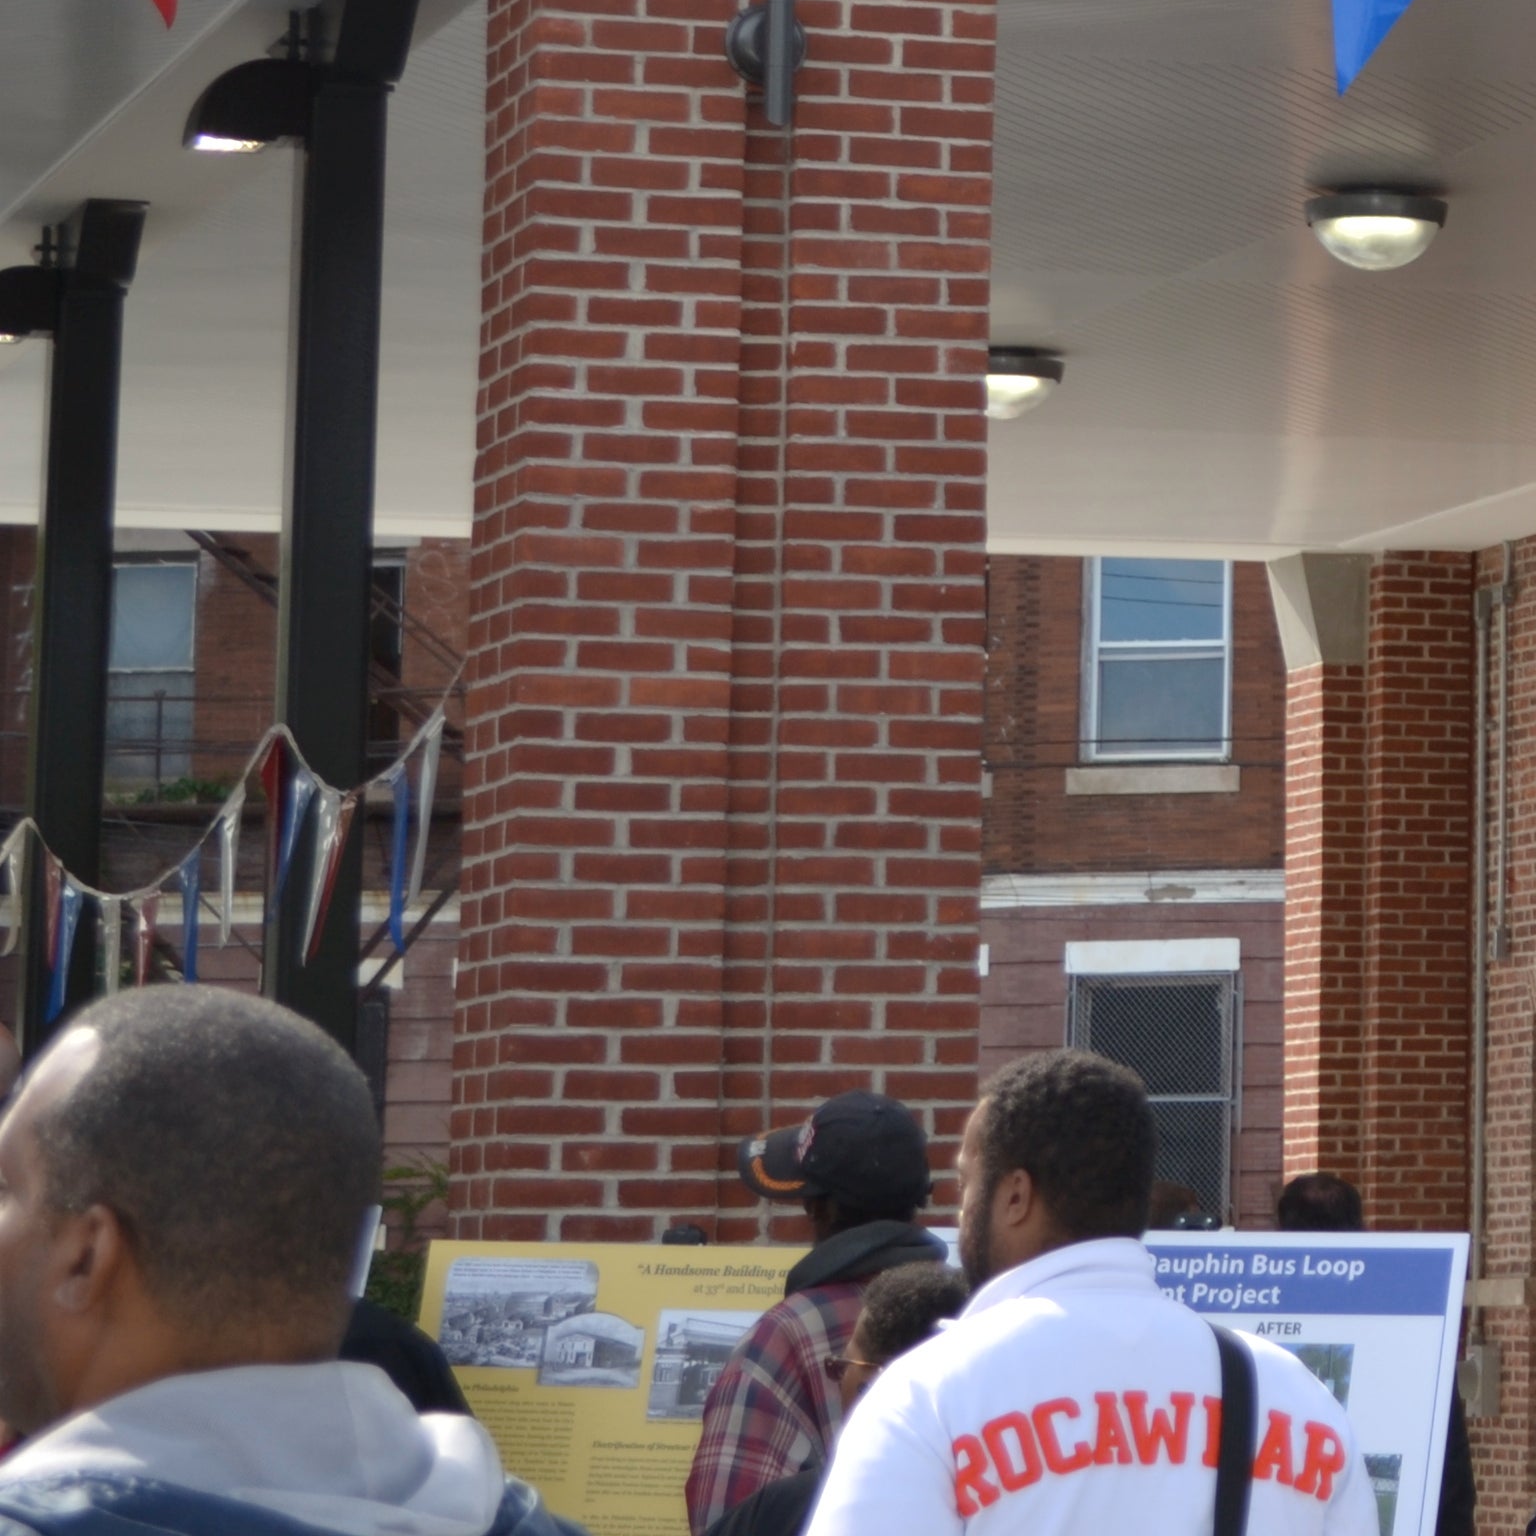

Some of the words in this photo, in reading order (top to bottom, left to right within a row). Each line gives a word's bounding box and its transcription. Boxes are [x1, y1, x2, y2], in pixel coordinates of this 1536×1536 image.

[654, 1264, 721, 1277] Handsome
[723, 1265, 776, 1280] Building
[1251, 1254, 1297, 1275] Bus
[1303, 1255, 1366, 1280] Loop
[747, 1284, 785, 1297] Dauphi
[1192, 1283, 1281, 1309] Project
[1255, 1322, 1302, 1335] AFTER
